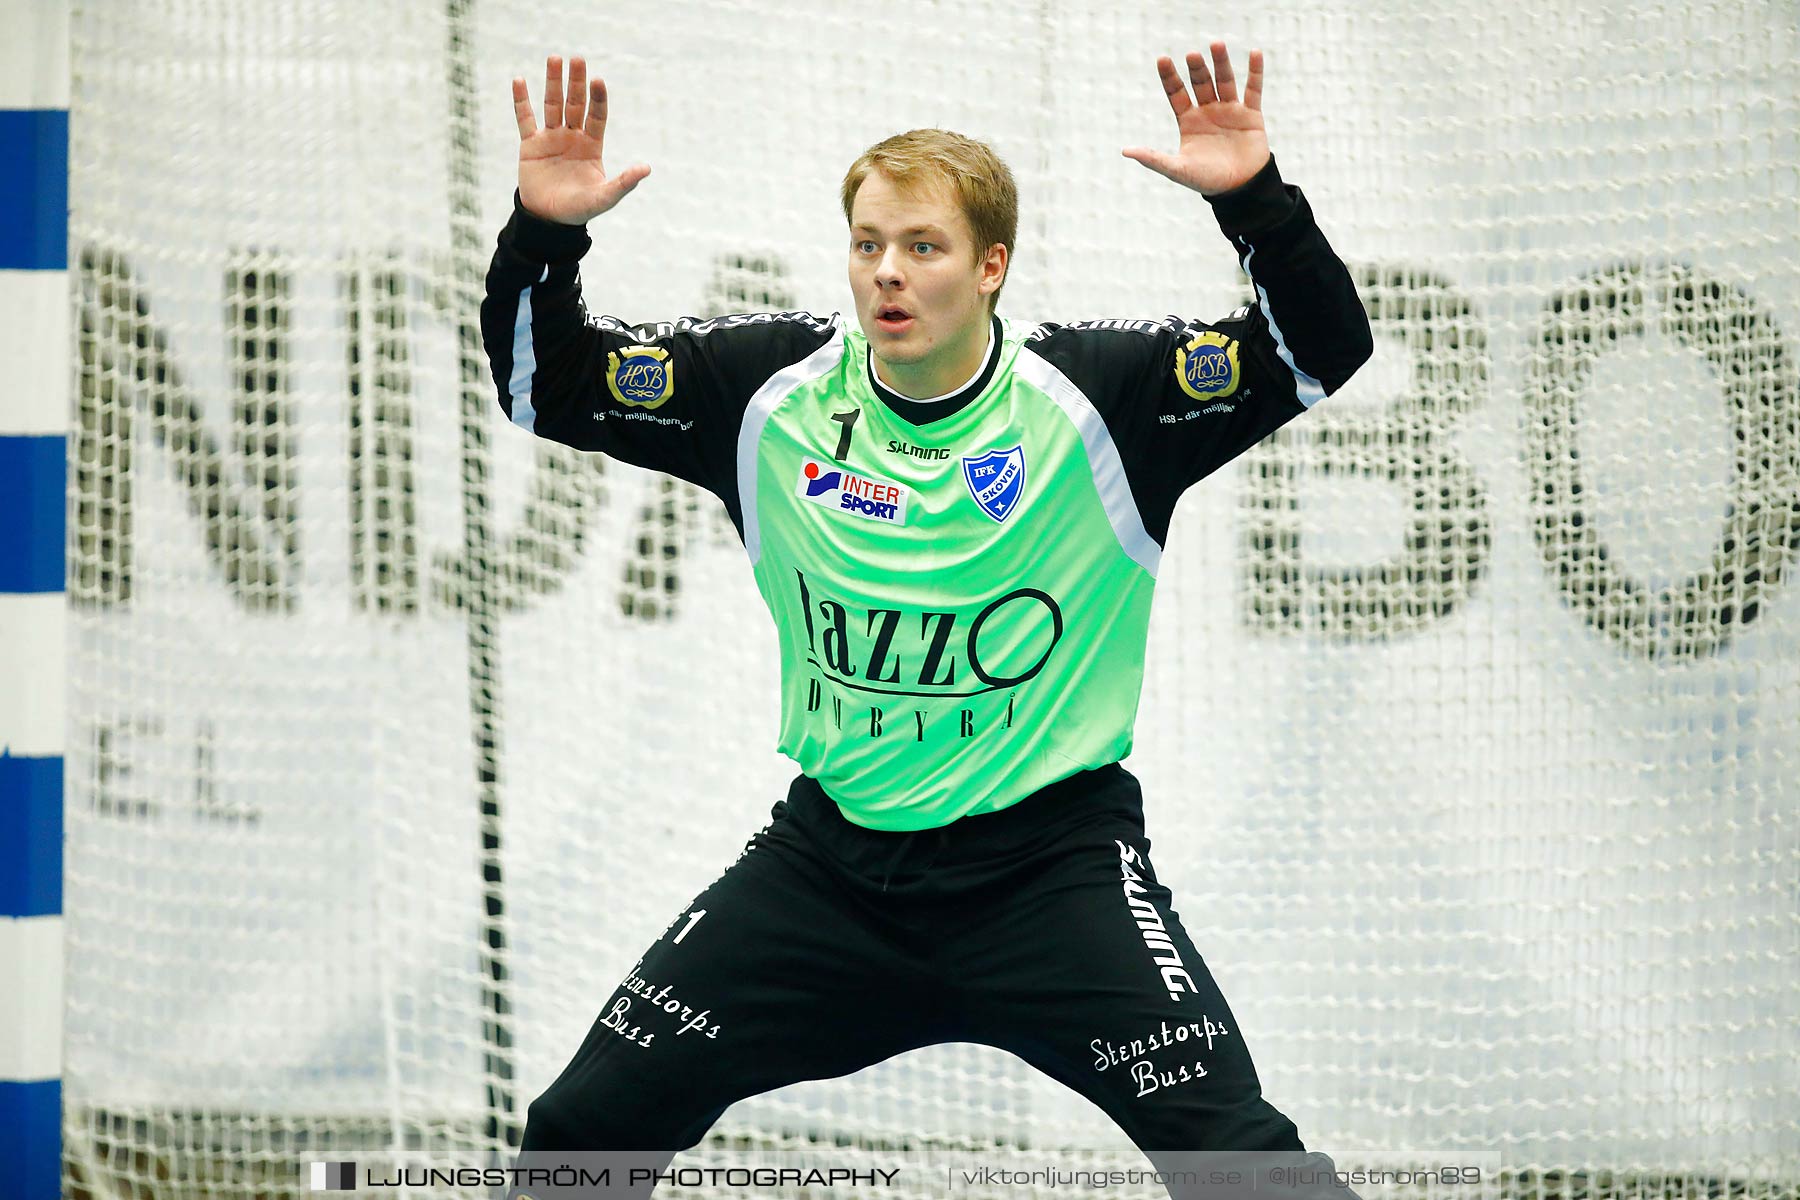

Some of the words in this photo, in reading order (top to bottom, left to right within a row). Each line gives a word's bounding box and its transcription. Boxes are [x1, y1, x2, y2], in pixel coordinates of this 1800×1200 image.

[618, 364, 664, 391] HSB
[1187, 353, 1228, 381] HSB
[1159, 414, 1176, 424] HSB
[1185, 410, 1201, 421] där
[830, 408, 860, 460] 1
[886, 440, 951, 460] SALMING
[974, 464, 997, 478] IFK
[982, 462, 1017, 501] SKÖVDE
[843, 474, 899, 504] INTER
[841, 493, 898, 520] SPORT
[673, 909, 707, 944] 1
[600, 996, 656, 1048] Buss
[1090, 1014, 1229, 1072] Stenstorps
[1131, 1060, 1208, 1098] Buss
